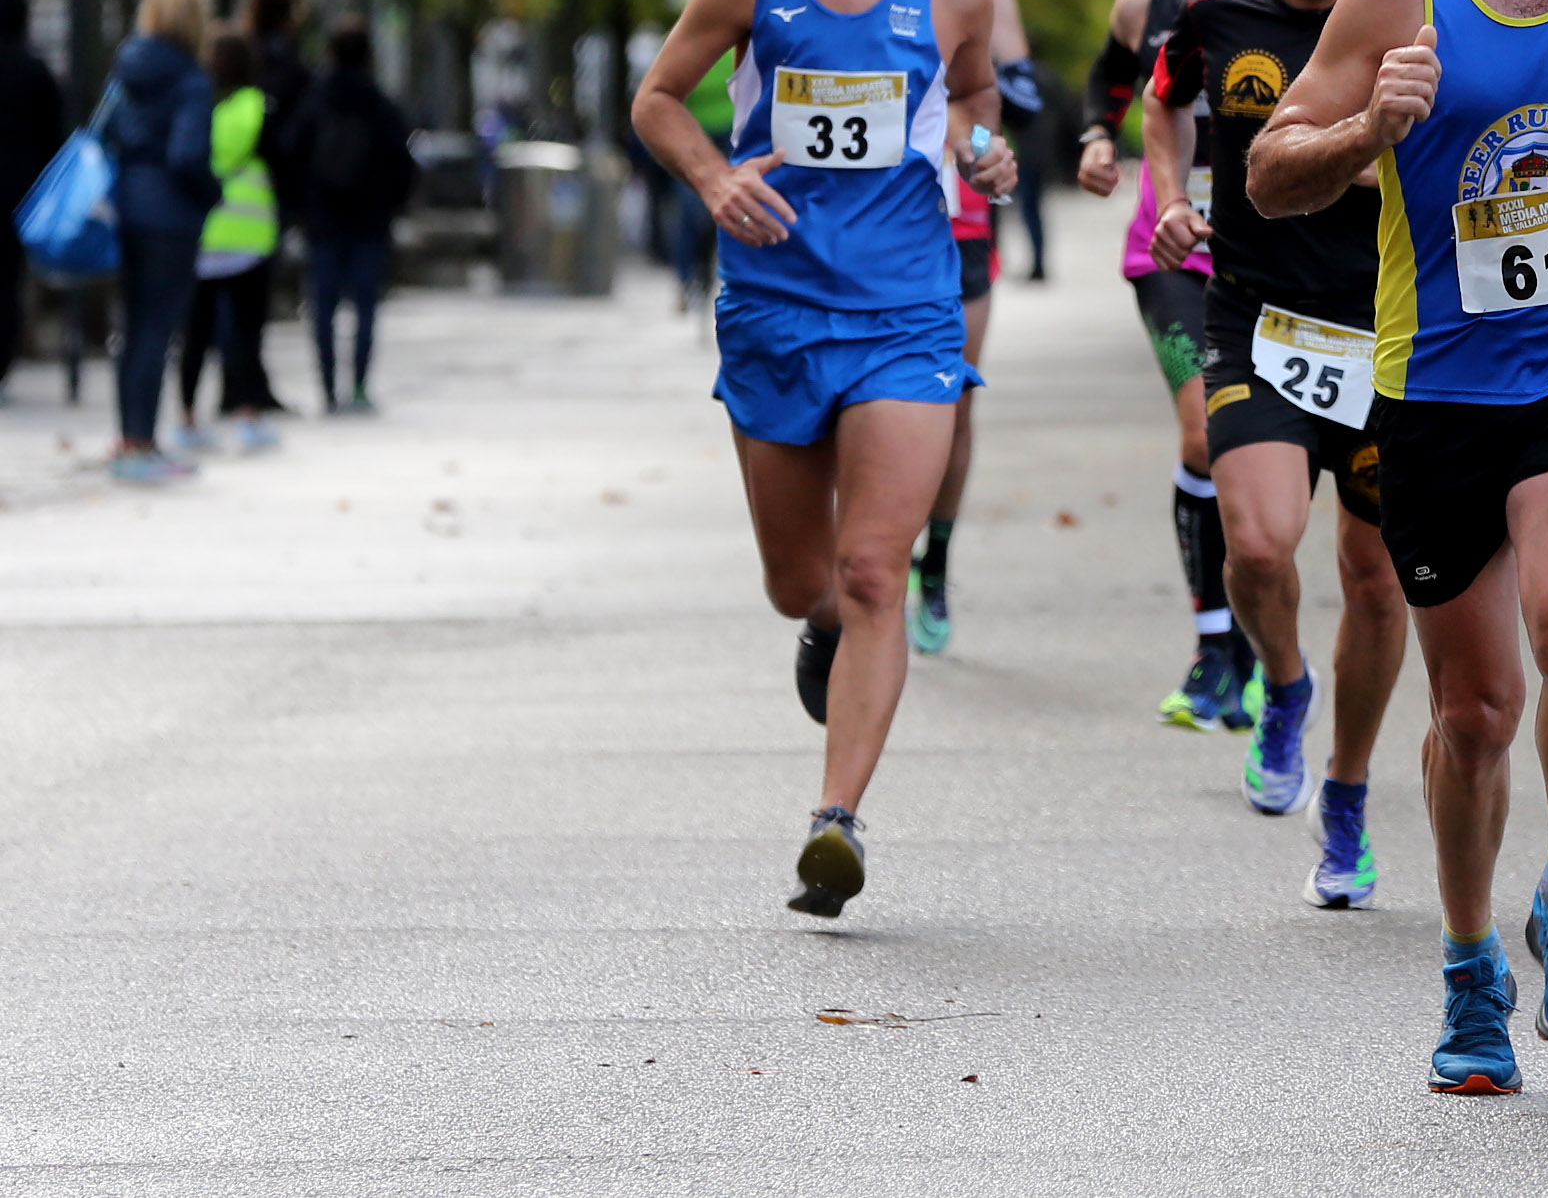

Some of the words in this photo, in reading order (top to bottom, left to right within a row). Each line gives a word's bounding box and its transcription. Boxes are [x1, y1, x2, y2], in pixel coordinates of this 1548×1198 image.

[806, 115, 868, 160] 33
[1462, 131, 1505, 201] BEER
[1497, 198, 1525, 214] XXXII
[1500, 206, 1539, 225] MEDIA
[1502, 224, 1514, 234] DE
[1282, 357, 1344, 408] 25
